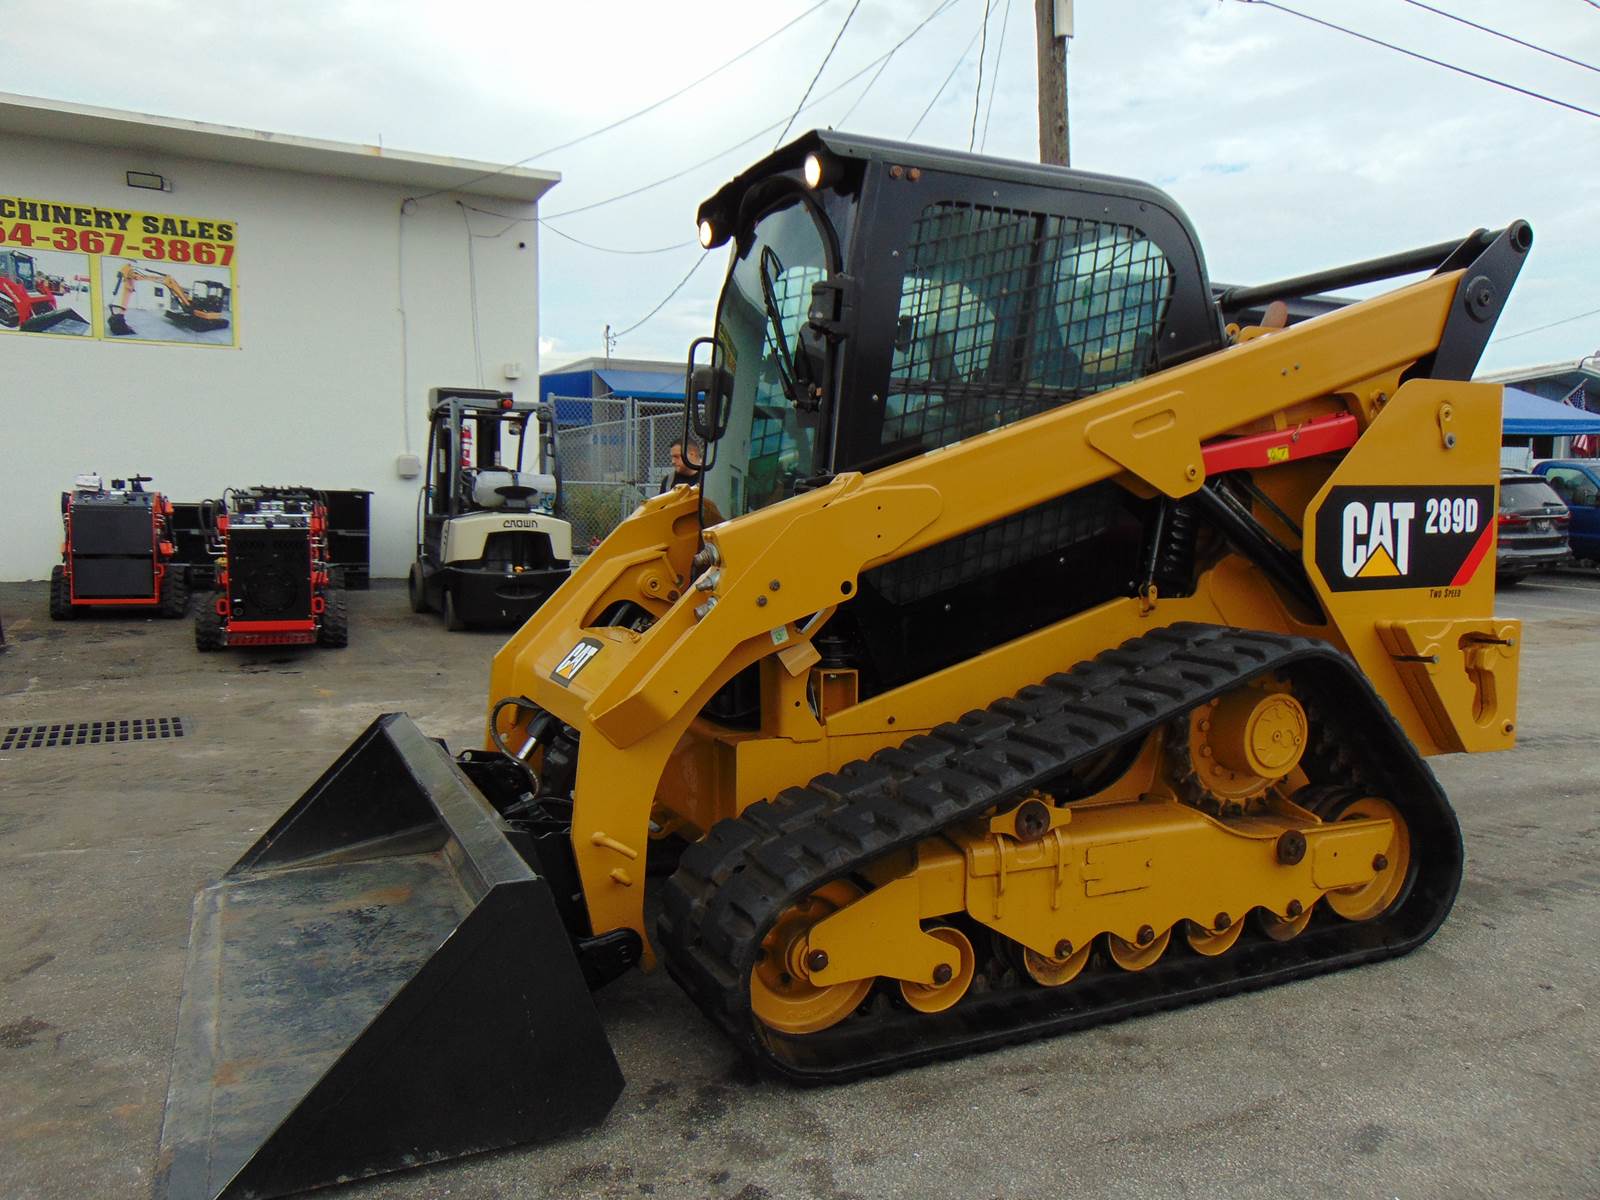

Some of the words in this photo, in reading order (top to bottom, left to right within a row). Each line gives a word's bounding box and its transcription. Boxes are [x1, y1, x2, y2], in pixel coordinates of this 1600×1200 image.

[0, 199, 131, 231] CHINERY
[142, 215, 234, 242] SALES
[0, 221, 235, 266] 4-367-3867
[503, 519, 538, 529] CROWN
[1342, 501, 1416, 578] CAT
[1425, 498, 1478, 534] 289D
[555, 641, 599, 680] CAT
